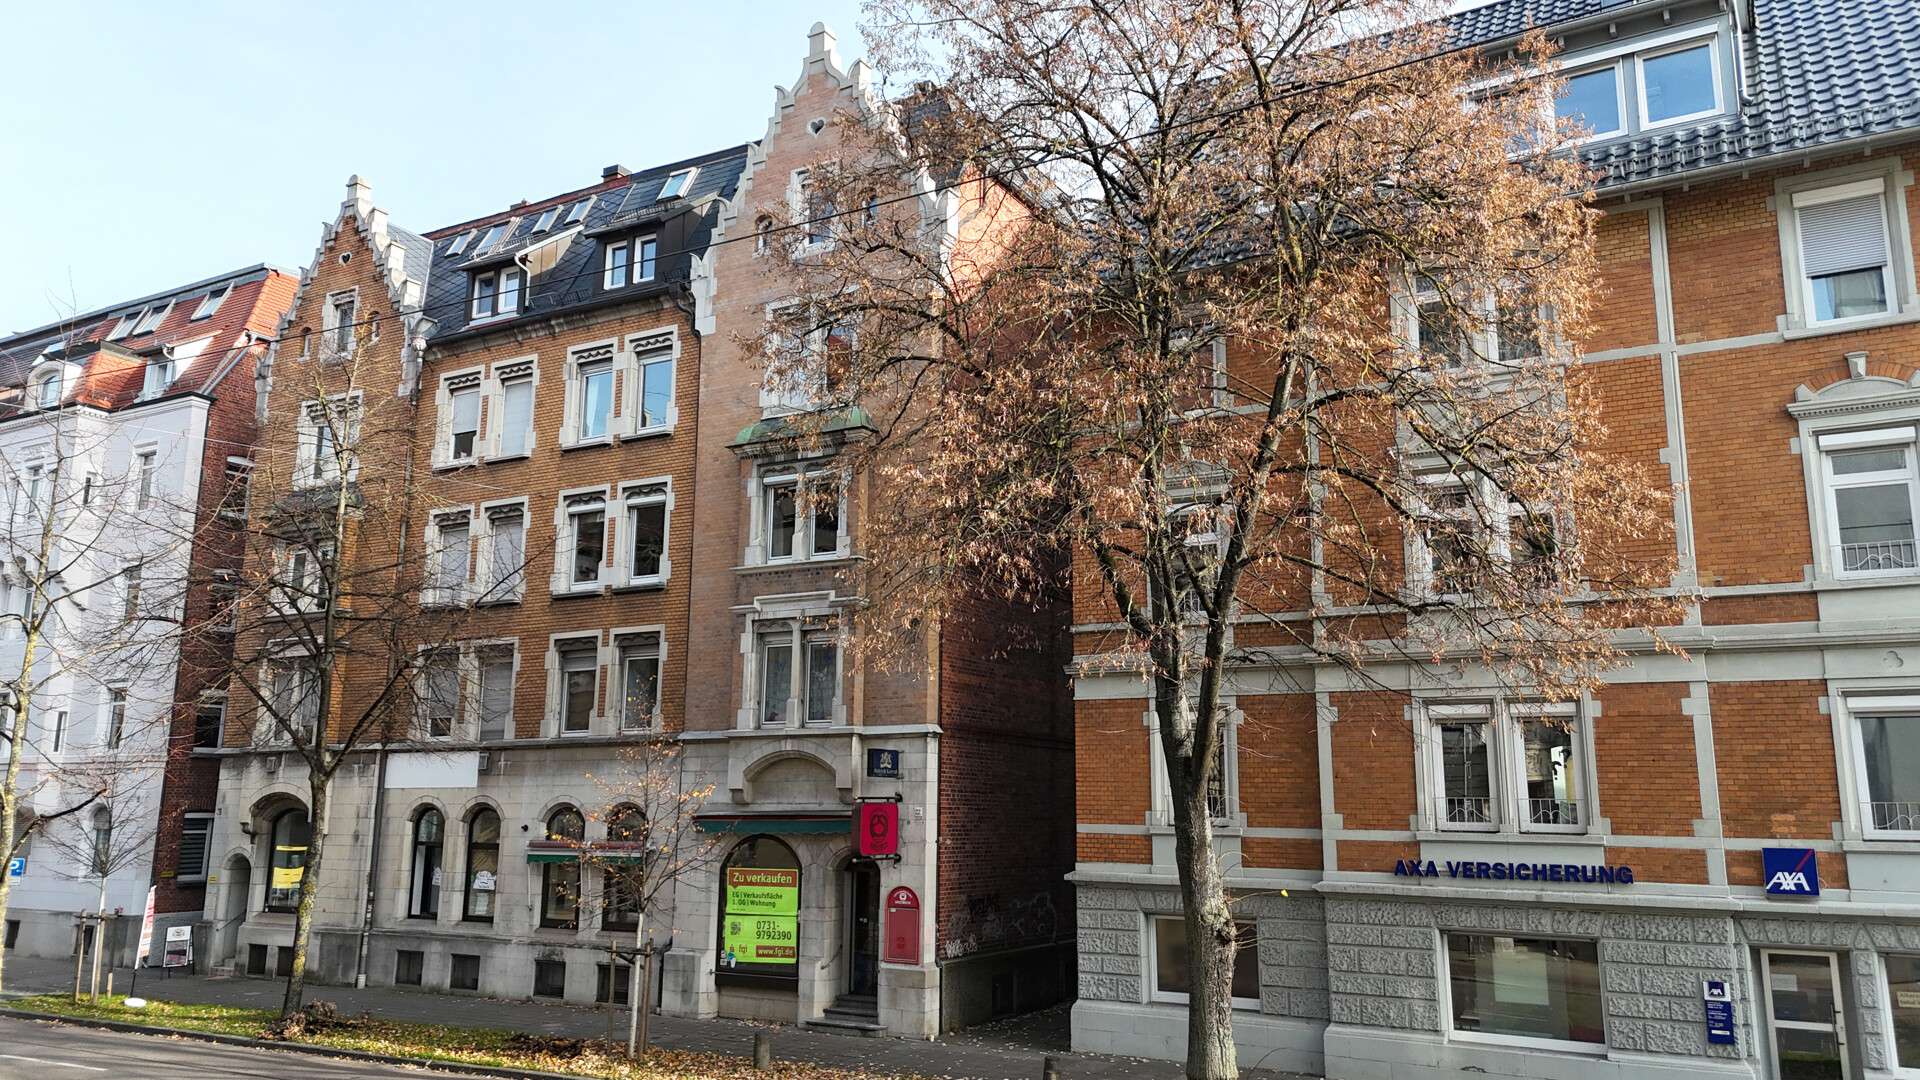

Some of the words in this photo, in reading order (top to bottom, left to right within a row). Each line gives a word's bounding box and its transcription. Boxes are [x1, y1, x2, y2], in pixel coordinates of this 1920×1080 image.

[1394, 859, 1440, 878] AXA
[1446, 861, 1634, 884] VERSICHERUNG
[733, 872, 745, 882] Zu
[746, 873, 792, 884] verkaufen
[1765, 871, 1811, 891] AXA
[750, 899, 776, 909] Wohnung
[756, 921, 780, 930] 0731-
[755, 930, 792, 941] 9792390
